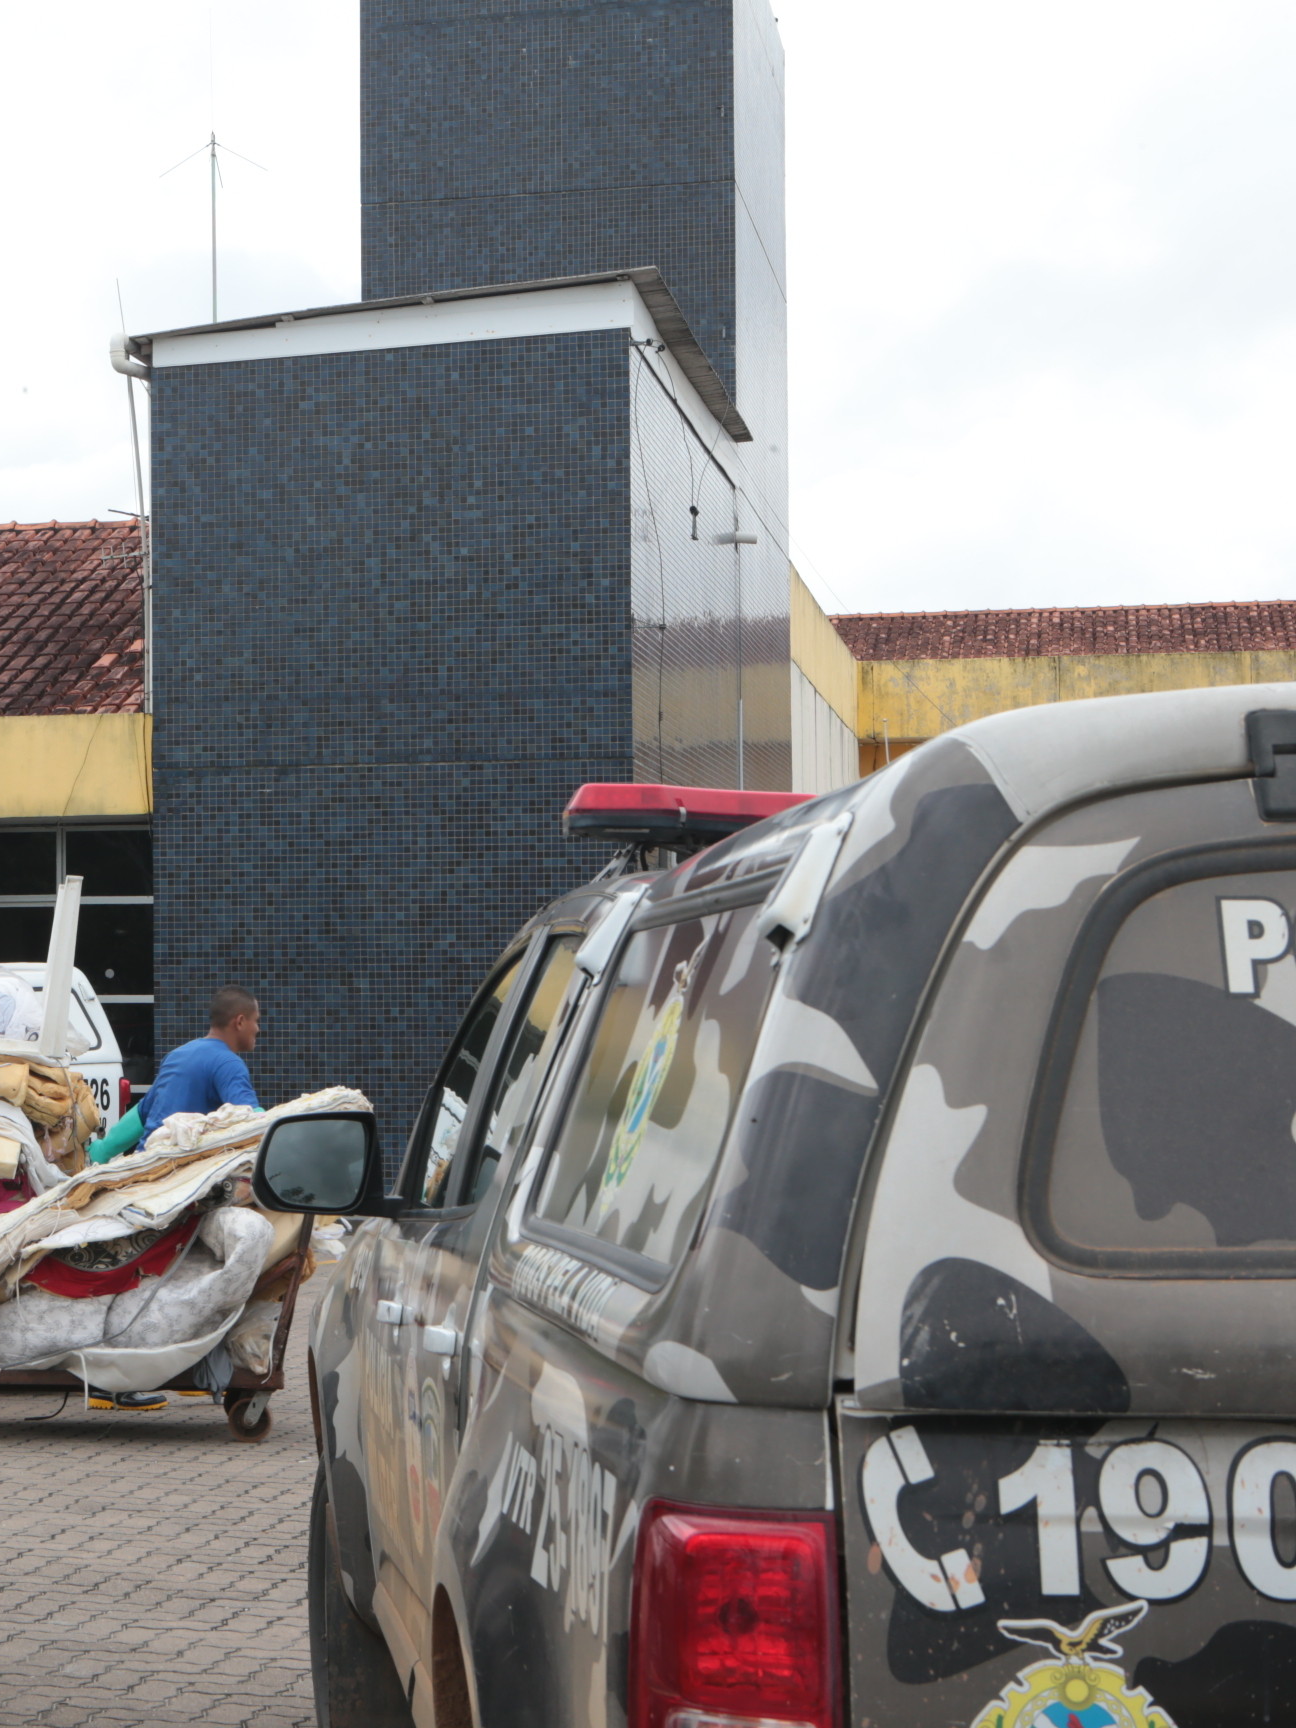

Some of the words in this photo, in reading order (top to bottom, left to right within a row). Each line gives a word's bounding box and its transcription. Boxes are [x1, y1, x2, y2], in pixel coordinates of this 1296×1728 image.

[502, 1440, 537, 1536] VTR
[530, 1418, 618, 1645] 25-1897
[998, 1436, 1296, 1604] 190
